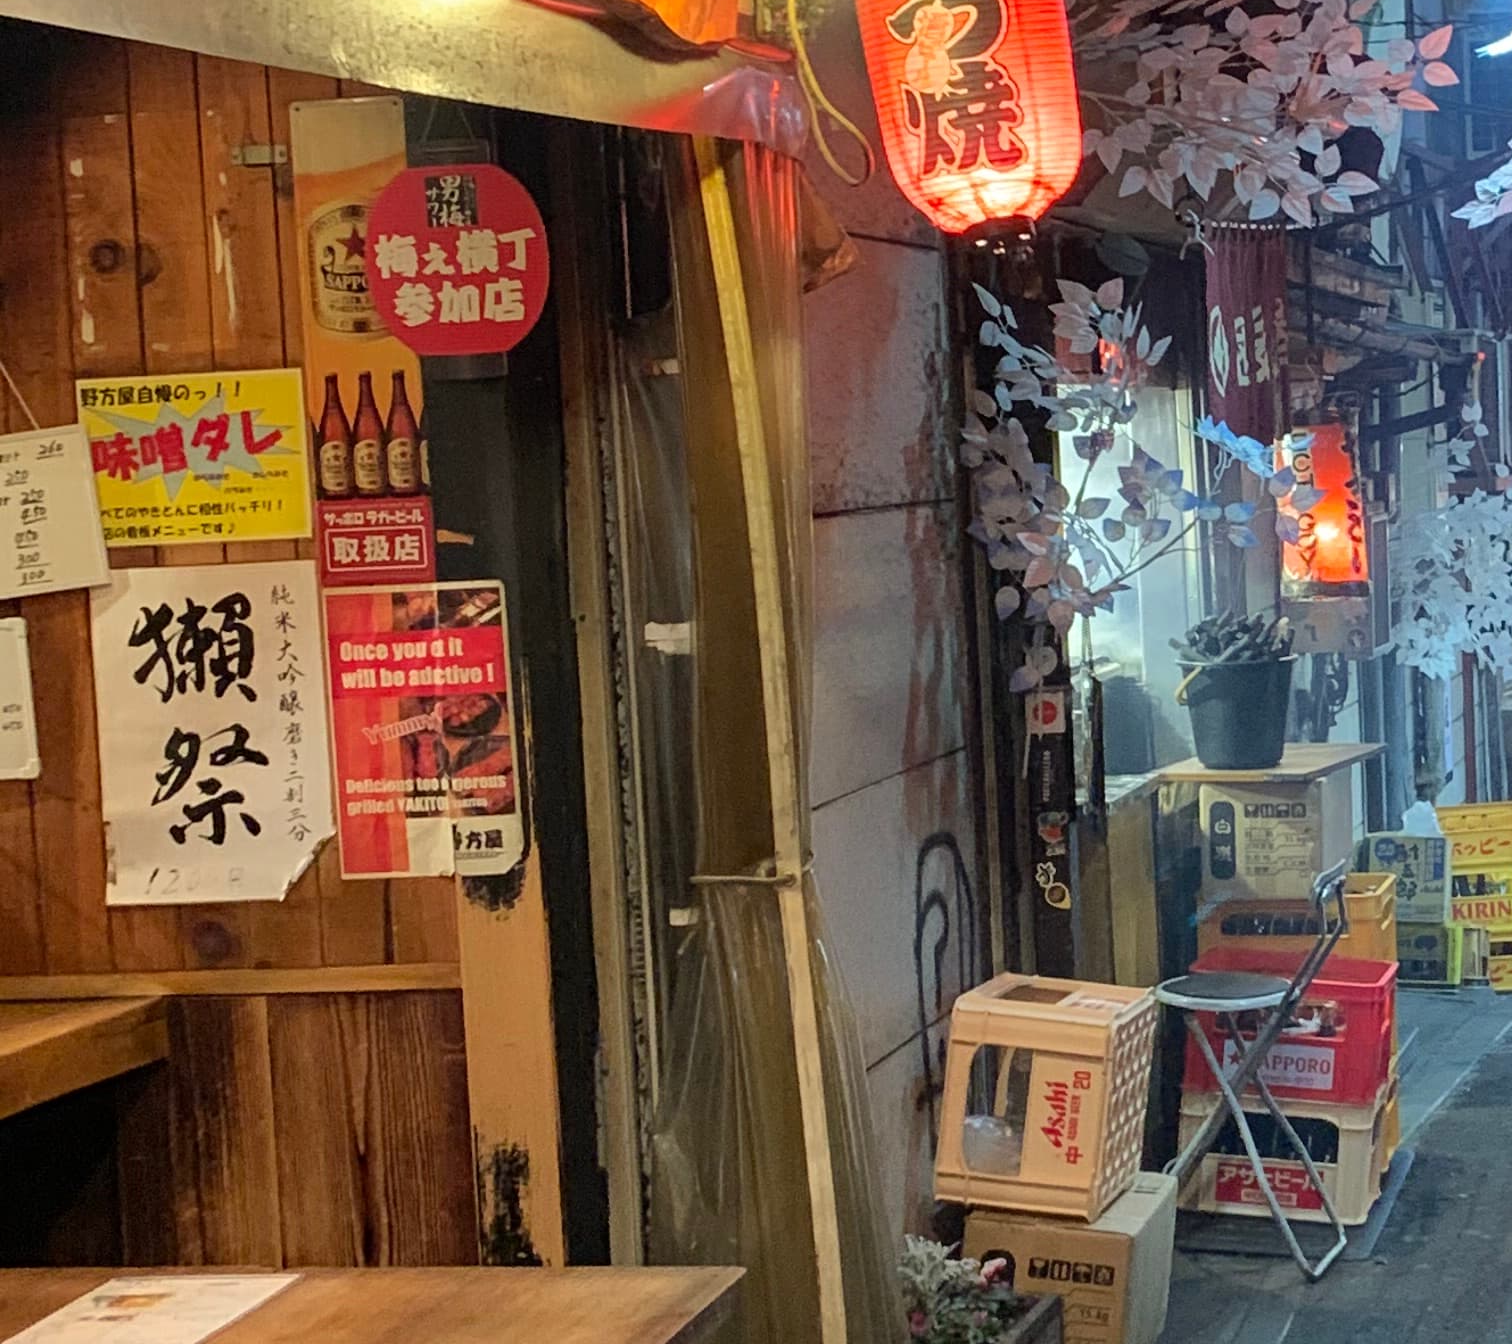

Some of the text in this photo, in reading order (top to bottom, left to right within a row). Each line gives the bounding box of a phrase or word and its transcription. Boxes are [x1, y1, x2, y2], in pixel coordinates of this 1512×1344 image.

[439, 175, 466, 227] 男梅
[394, 277, 525, 327] 参加店
[91, 410, 283, 482] 味噌ダレ
[332, 534, 420, 563] 取扱店
[340, 641, 389, 662] Once
[393, 640, 427, 662] you
[448, 637, 463, 656] it
[341, 669, 376, 689] will
[380, 668, 405, 688] be
[346, 775, 414, 795] Delicious
[347, 795, 395, 817] grilled
[398, 795, 450, 814] YAKITO
[1452, 900, 1512, 922] KIRIN
[1072, 1070, 1092, 1090] 20
[1041, 1080, 1069, 1148] Asahi
[1065, 1145, 1084, 1164] 中
